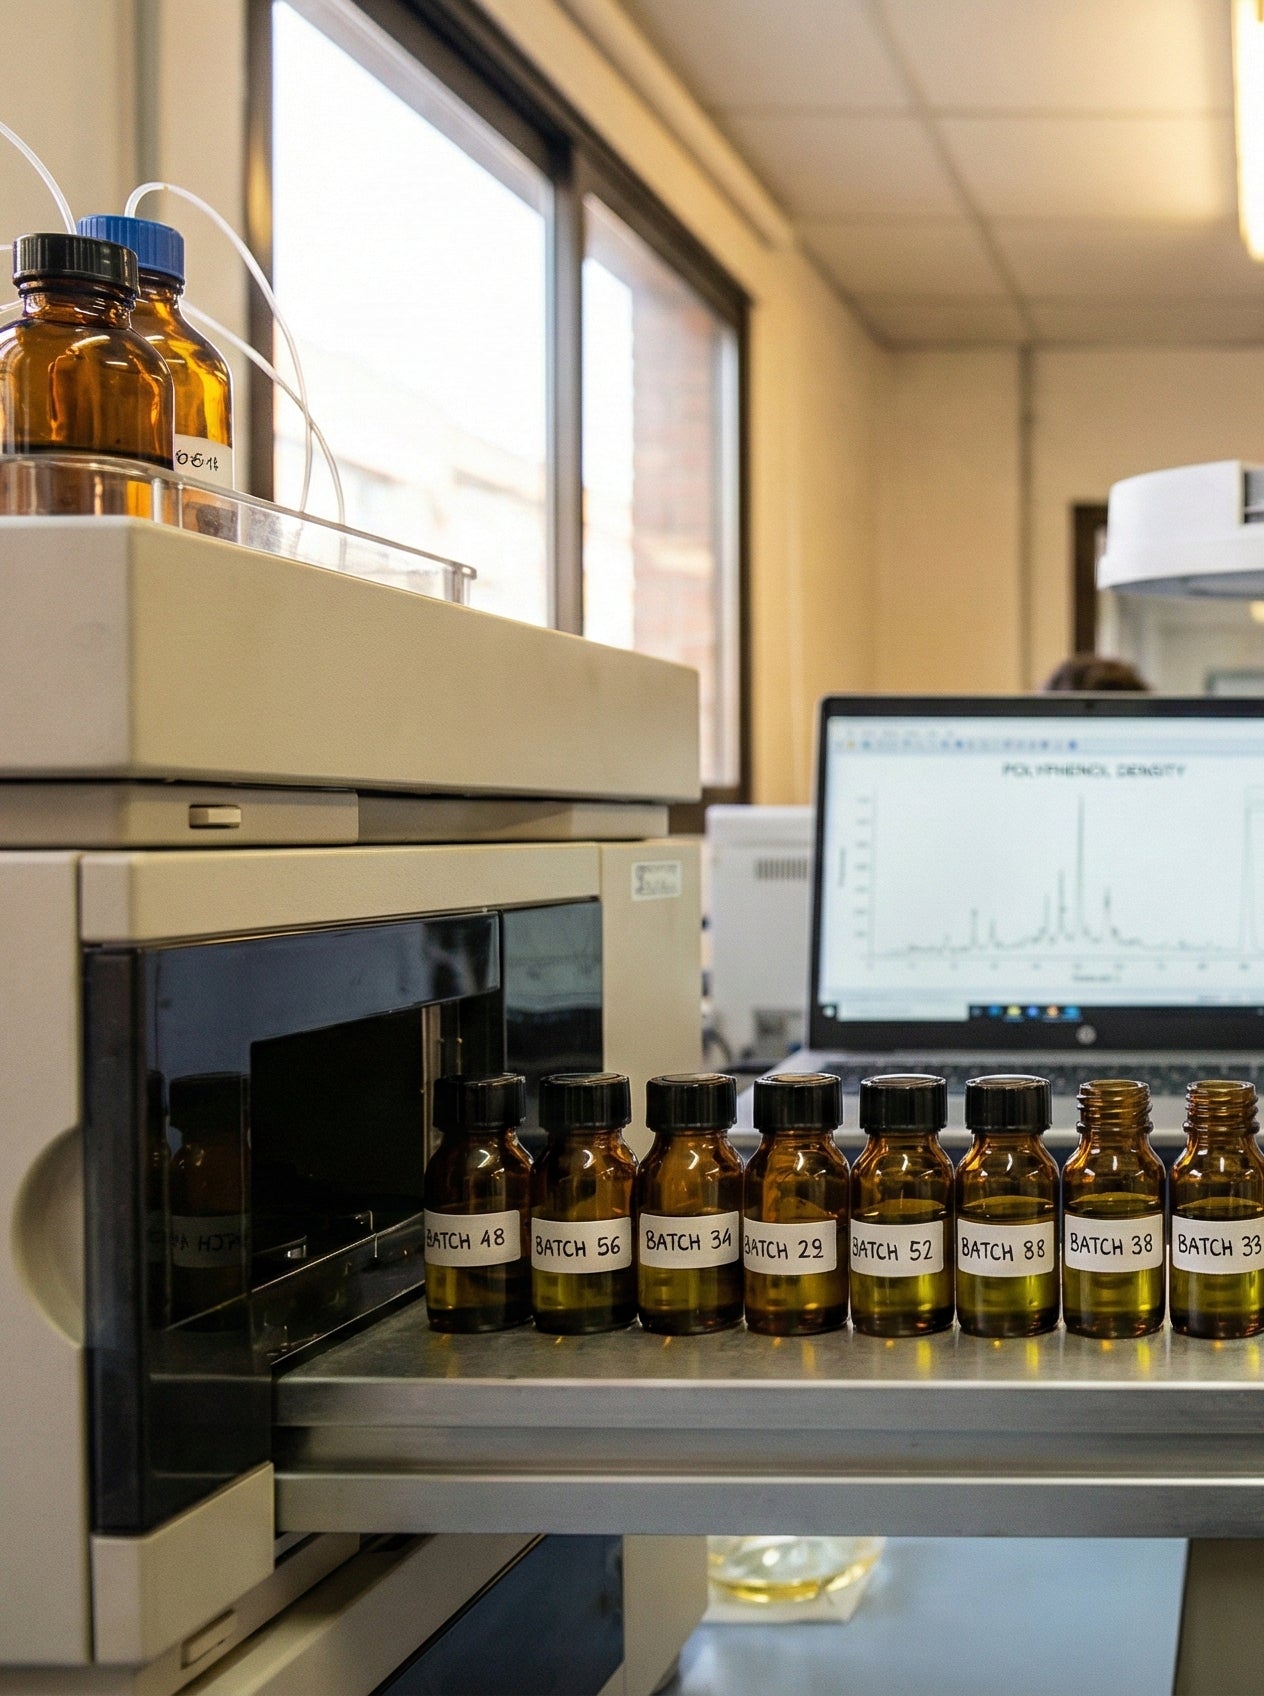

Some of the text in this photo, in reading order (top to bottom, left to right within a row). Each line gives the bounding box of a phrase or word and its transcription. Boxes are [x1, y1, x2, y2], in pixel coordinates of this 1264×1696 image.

[1002, 761, 1187, 778] POLYPHENOL DENSITY
[426, 1228, 505, 1250] BATCH 48
[535, 1235, 621, 1257] BATCH 56
[645, 1228, 732, 1251] BATCH 34
[798, 1238, 824, 1259] 29
[852, 1237, 933, 1261] BATCH 52
[961, 1237, 1045, 1262] BATCH 88
[1070, 1232, 1153, 1256] BATCH 38
[1178, 1234, 1262, 1256] BATCH 33
